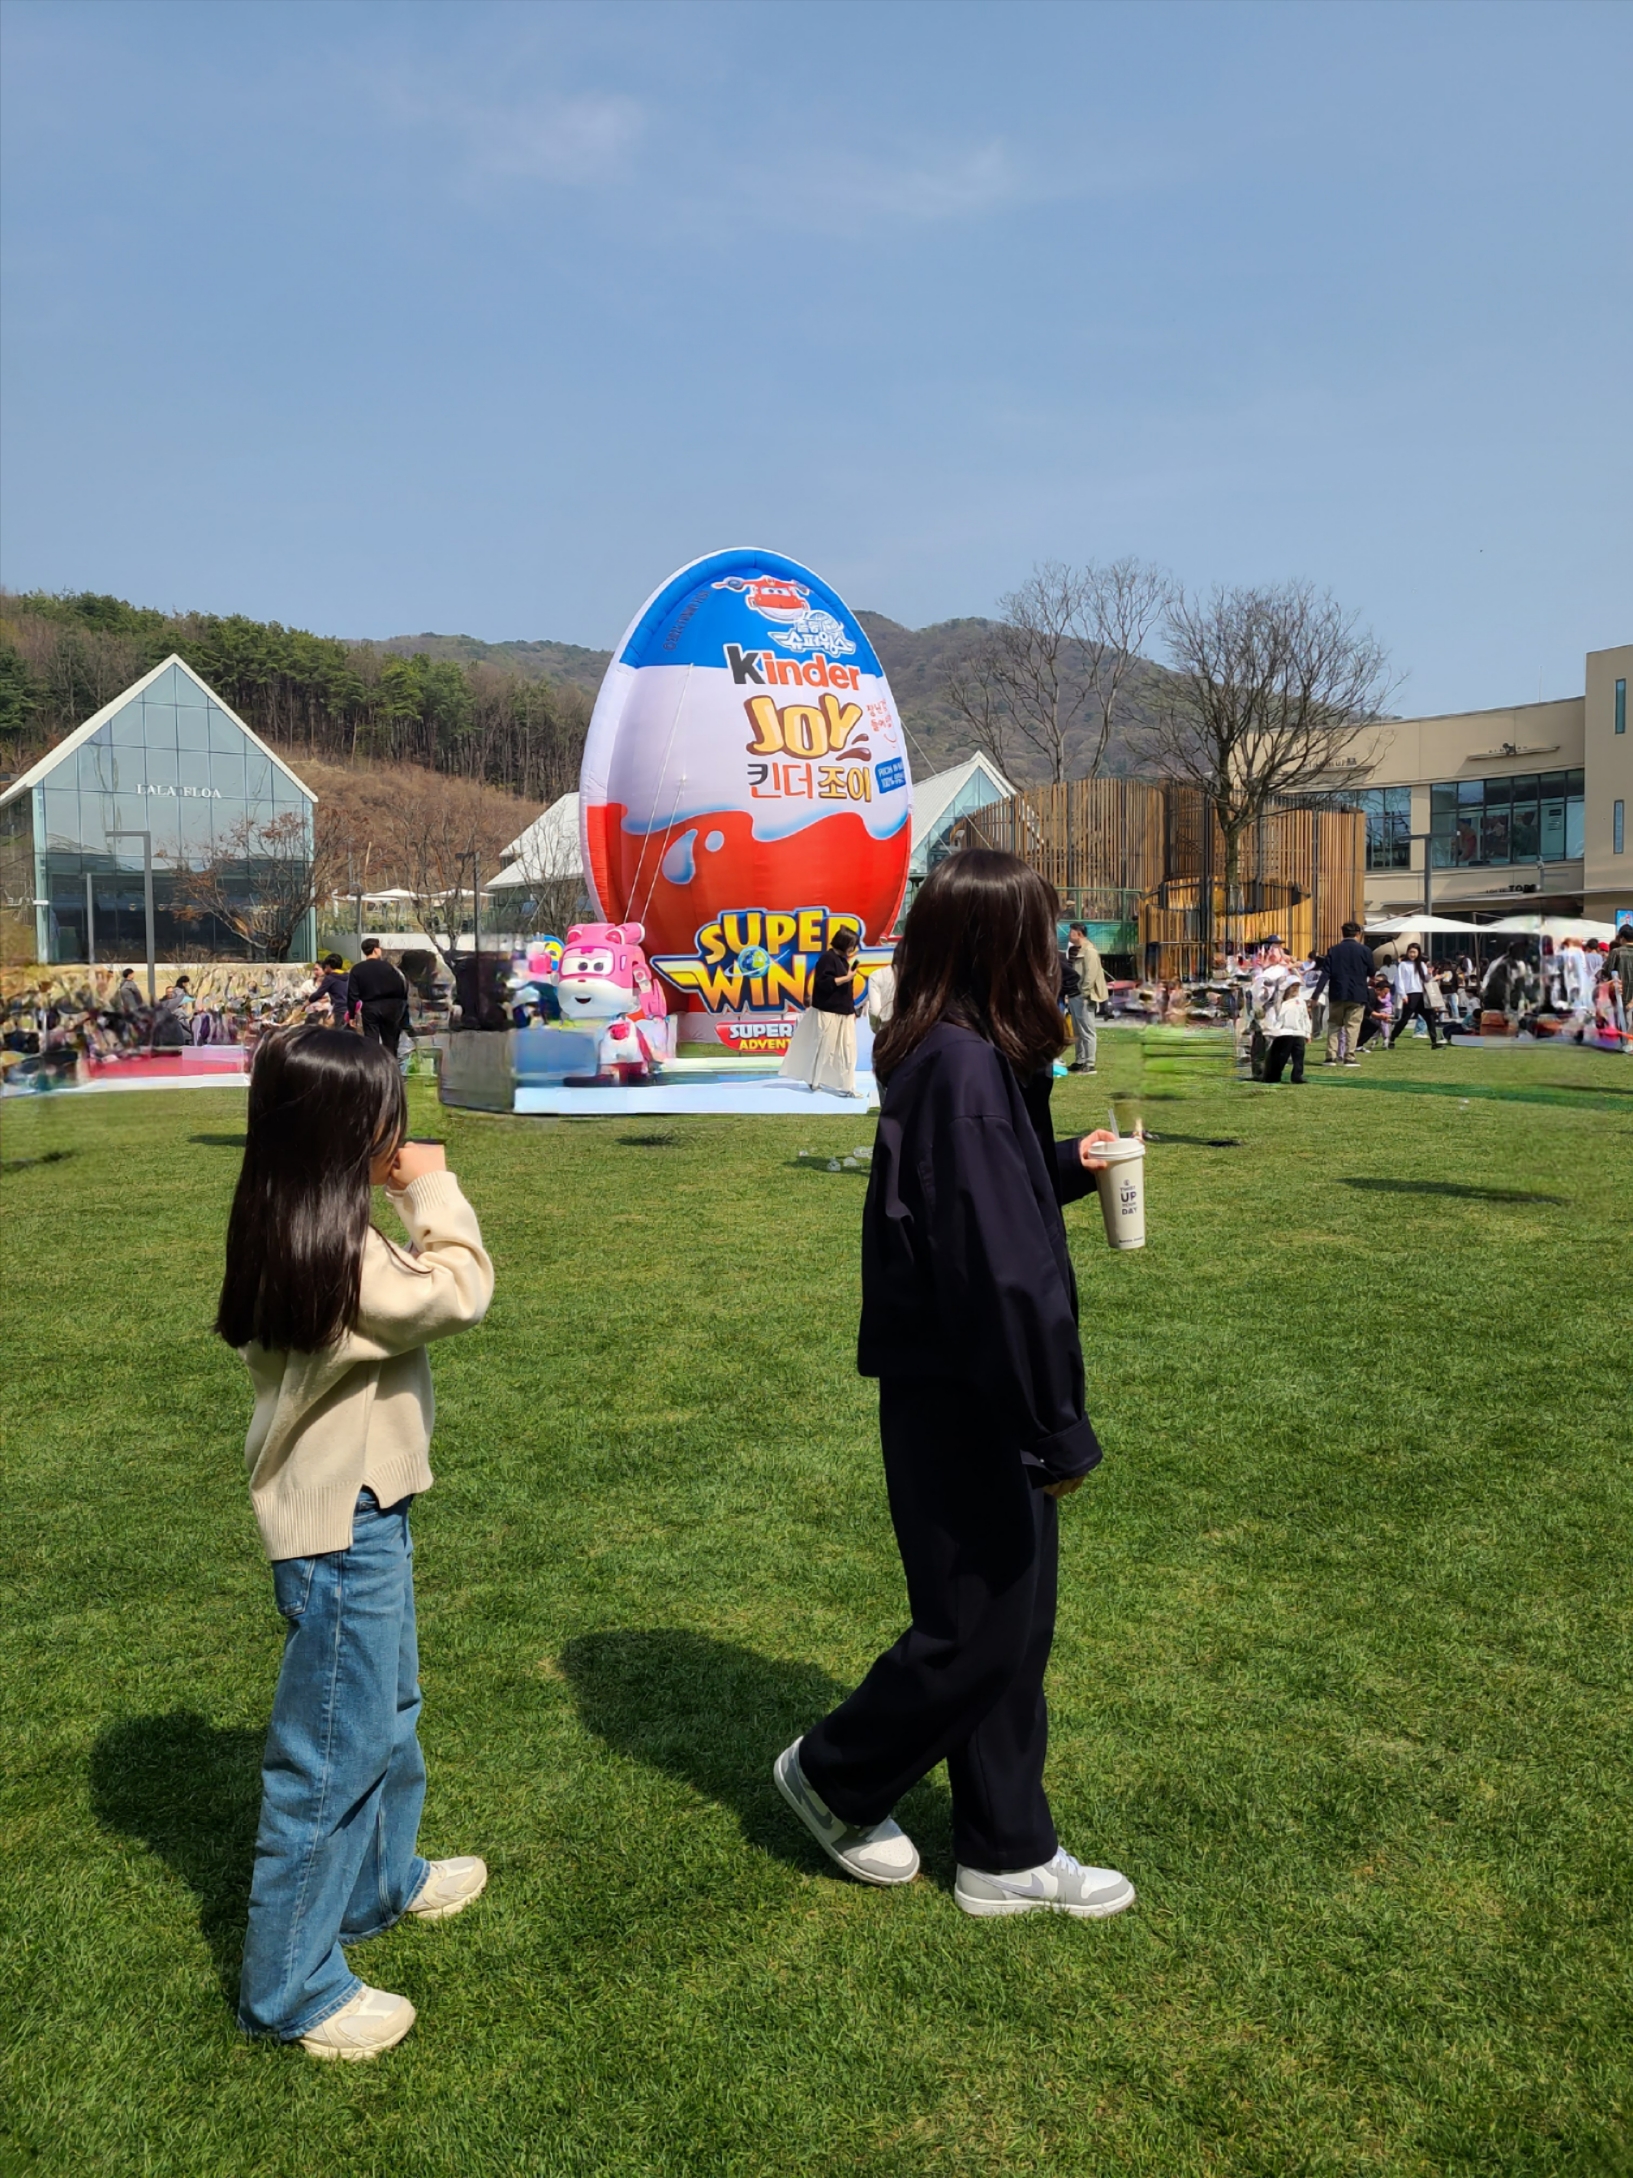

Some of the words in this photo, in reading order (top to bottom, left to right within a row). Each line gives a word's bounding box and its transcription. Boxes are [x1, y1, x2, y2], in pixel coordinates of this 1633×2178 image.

[726, 645, 861, 691] Kinder
[744, 692, 863, 760] JOY
[136, 783, 176, 797] LALA
[183, 786, 222, 799] FLOA
[729, 1023, 793, 1039] SUPER
[1121, 1191, 1137, 1202] UP
